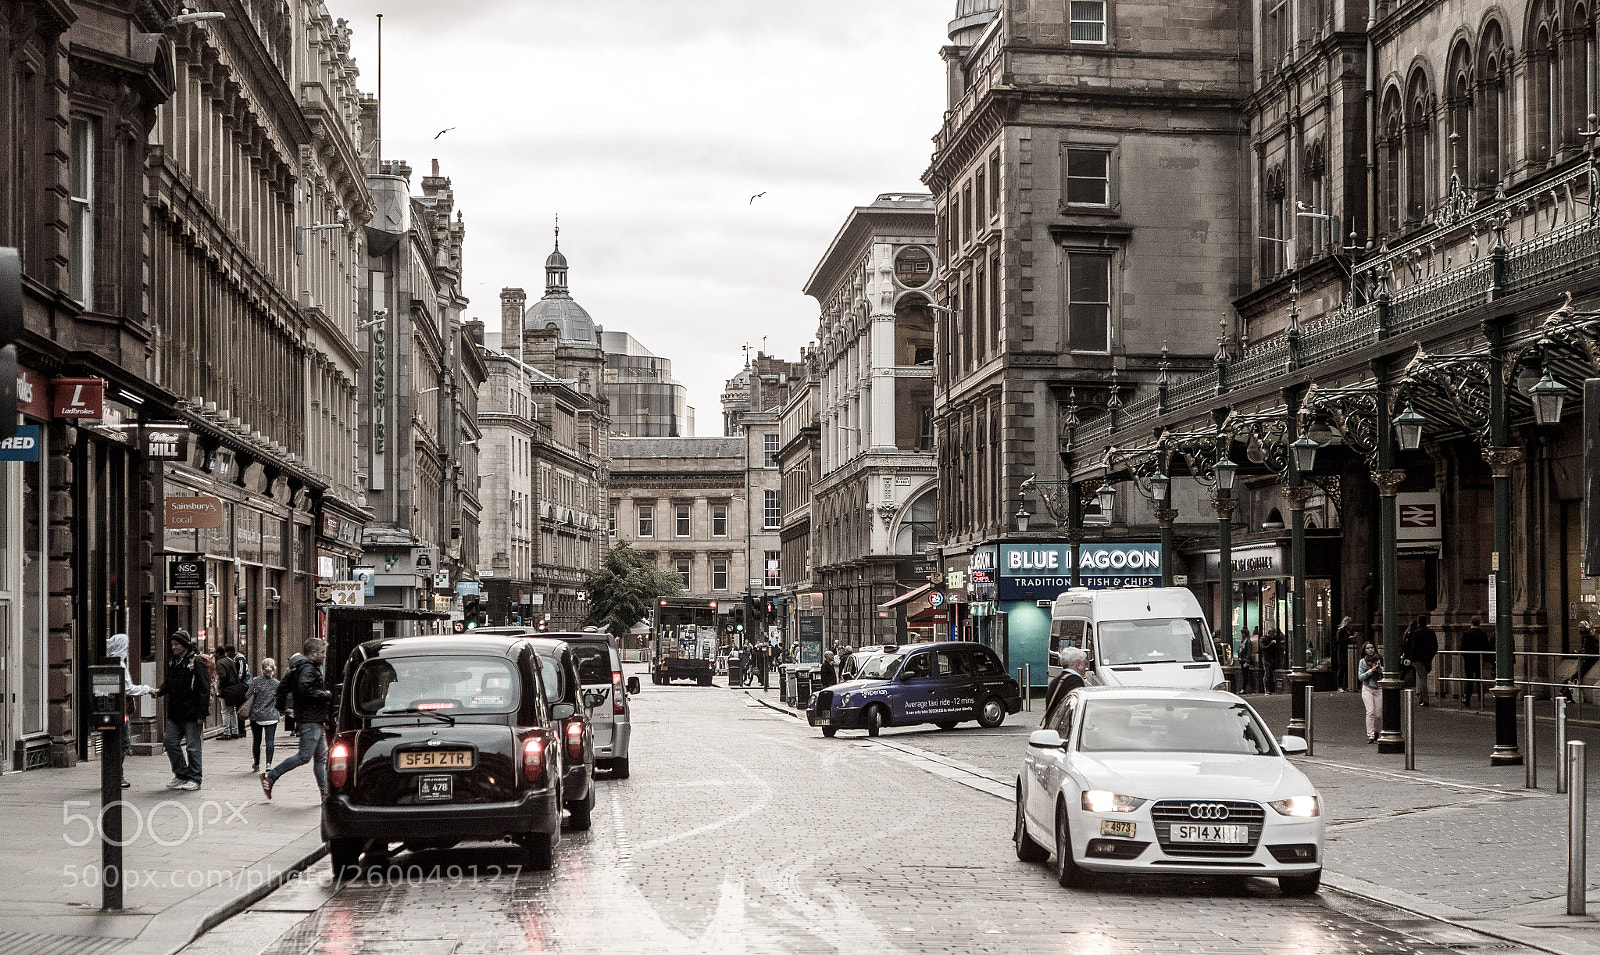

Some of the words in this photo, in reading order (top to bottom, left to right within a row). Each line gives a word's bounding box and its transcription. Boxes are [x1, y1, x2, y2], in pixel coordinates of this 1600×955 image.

[71, 384, 85, 406] L
[0, 436, 35, 449] RED
[148, 443, 179, 456] HILL
[172, 516, 193, 524] Local
[1008, 550, 1059, 569] BLUE
[1014, 578, 1085, 587] TRADITIONL
[1087, 578, 1110, 586] FISH
[1113, 578, 1121, 586] &
[1124, 577, 1154, 586] CHIPS
[338, 592, 356, 604] 24
[905, 700, 928, 709] Average
[940, 698, 950, 706] ride
[406, 753, 435, 765] SF51
[439, 753, 464, 765] ZTR
[432, 783, 448, 791] 478
[1111, 822, 1131, 832] 4973
